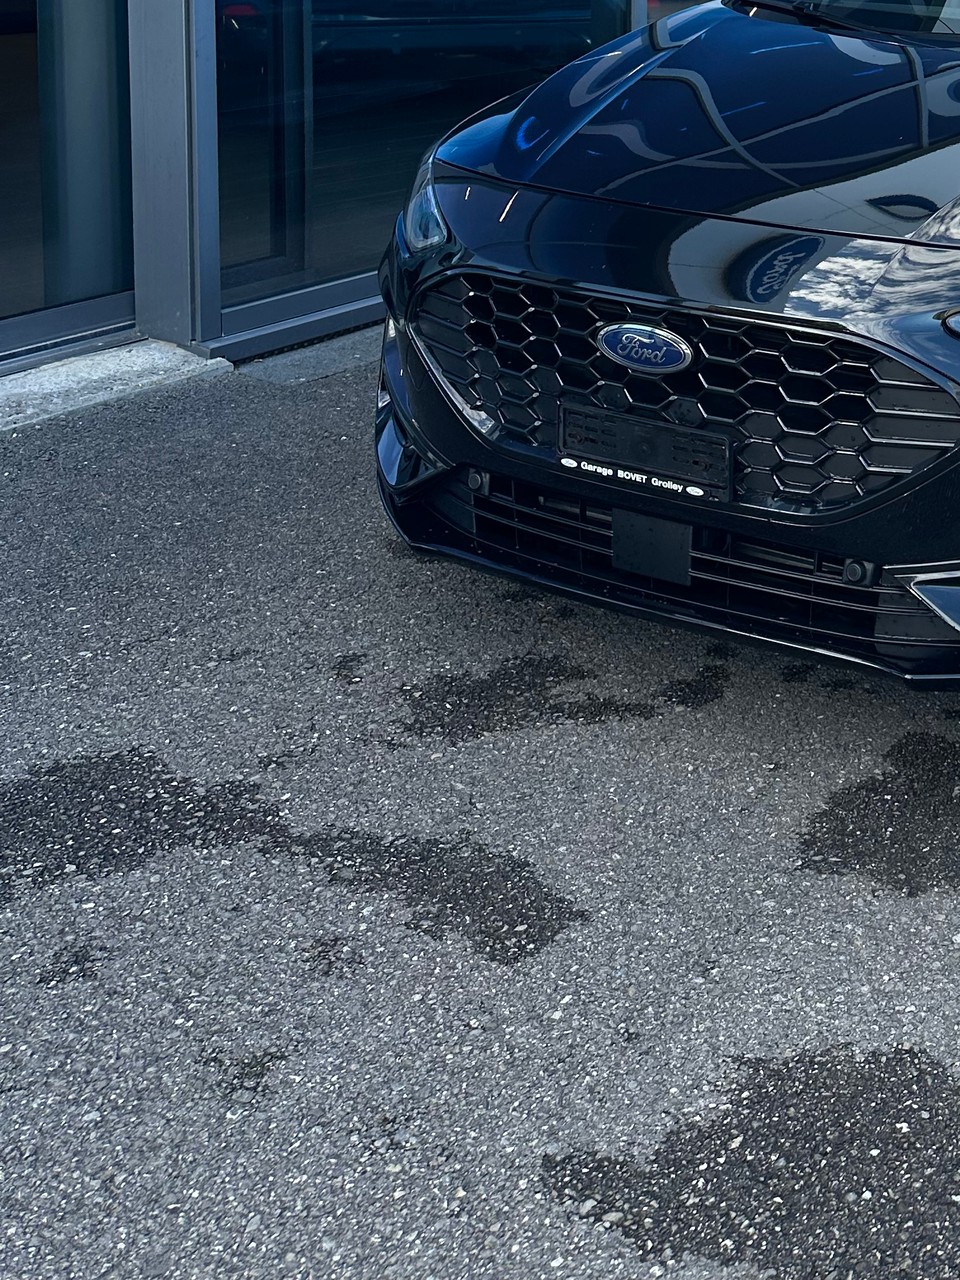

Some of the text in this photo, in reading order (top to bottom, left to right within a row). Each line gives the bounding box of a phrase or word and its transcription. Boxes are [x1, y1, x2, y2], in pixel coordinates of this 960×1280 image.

[616, 333, 667, 364] Ford
[580, 461, 613, 476] Garage
[617, 469, 648, 484] BOVET
[651, 477, 684, 493] Grolley
